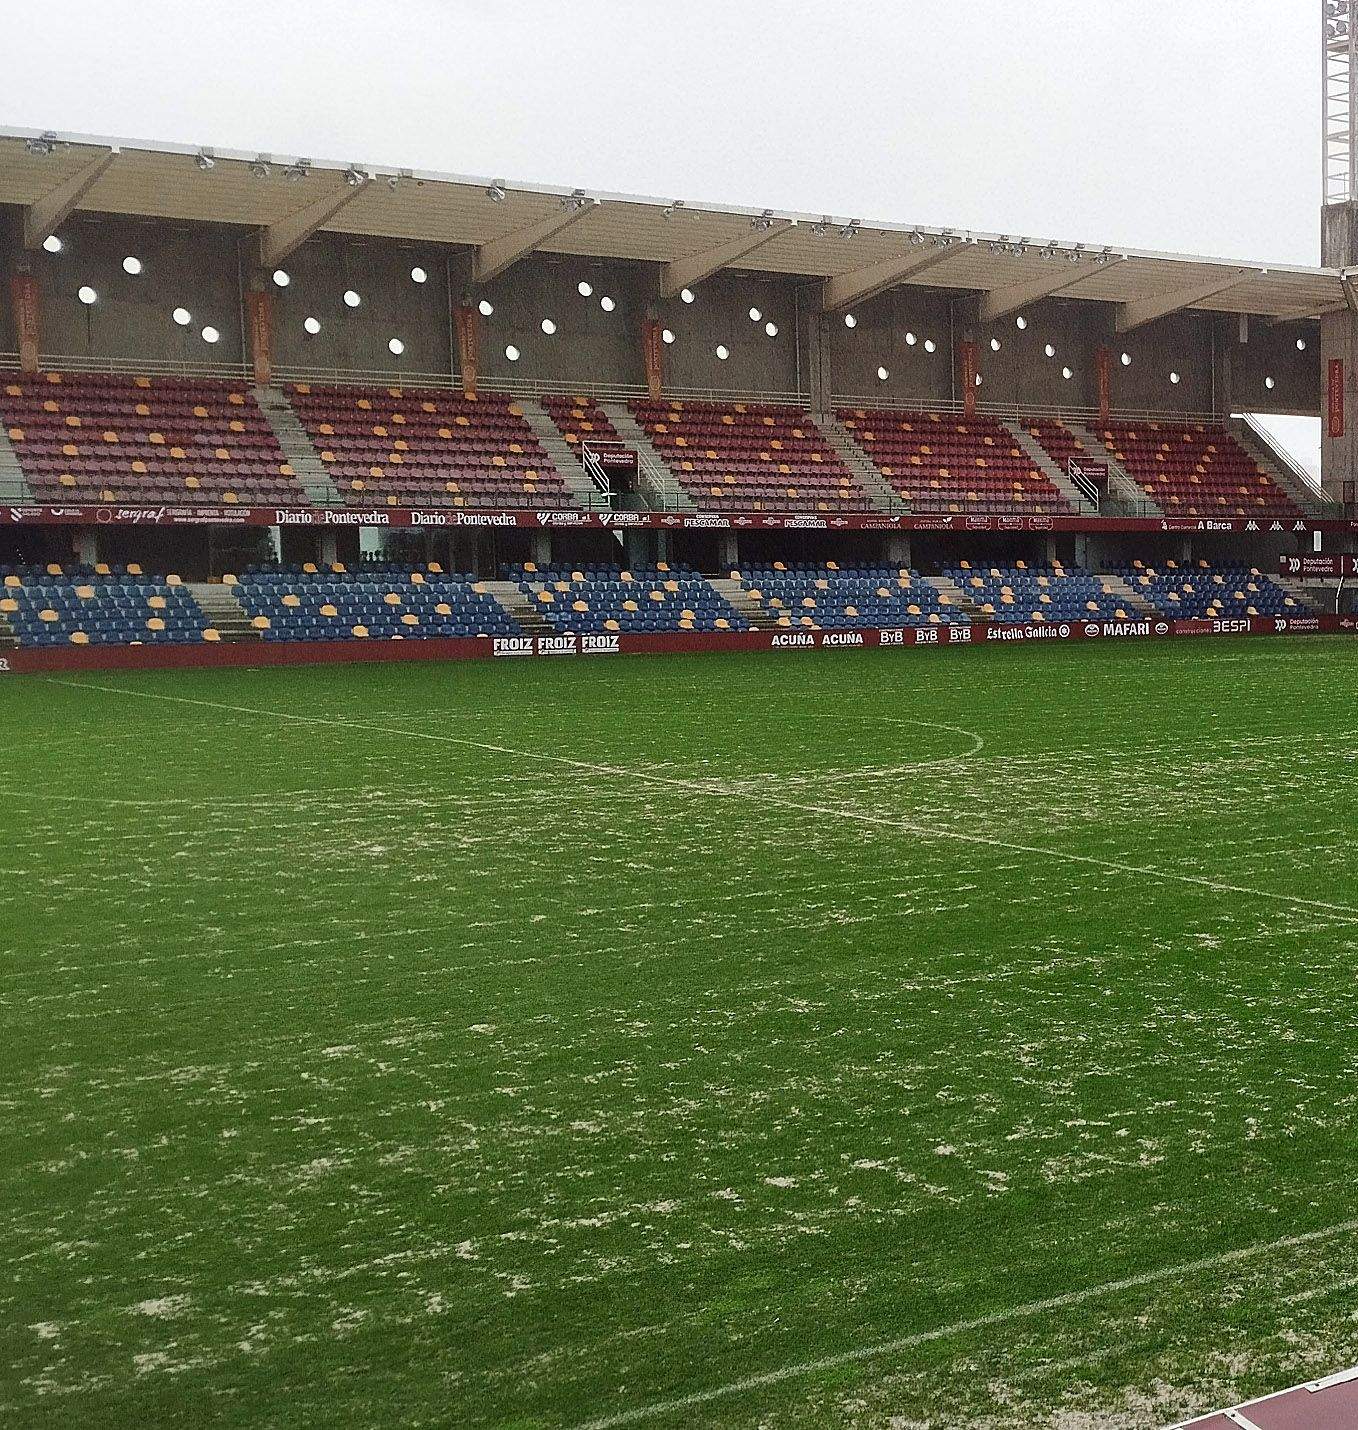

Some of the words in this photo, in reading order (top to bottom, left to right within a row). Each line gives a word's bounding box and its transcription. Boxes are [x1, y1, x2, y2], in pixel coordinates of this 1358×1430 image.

[276, 511, 312, 524] Diario
[324, 511, 389, 524] Pontevedra
[411, 512, 445, 525] Diario
[457, 513, 517, 526] Pontevedra
[684, 519, 730, 528] PESCAMAR
[785, 520, 827, 528] PESCAMAR
[1198, 521, 1204, 529] A
[1207, 521, 1232, 529] Barca
[1303, 558, 1334, 567] Deputación
[987, 627, 1024, 640] Estrella
[1025, 626, 1057, 638] Galicia
[1103, 623, 1149, 636] MAFARI
[538, 637, 577, 649] FROIZ
[582, 636, 619, 648] FROIZ
[771, 631, 815, 646] ACUÑA
[822, 631, 863, 644] ACUÑA
[494, 638, 533, 650] FROIZ
